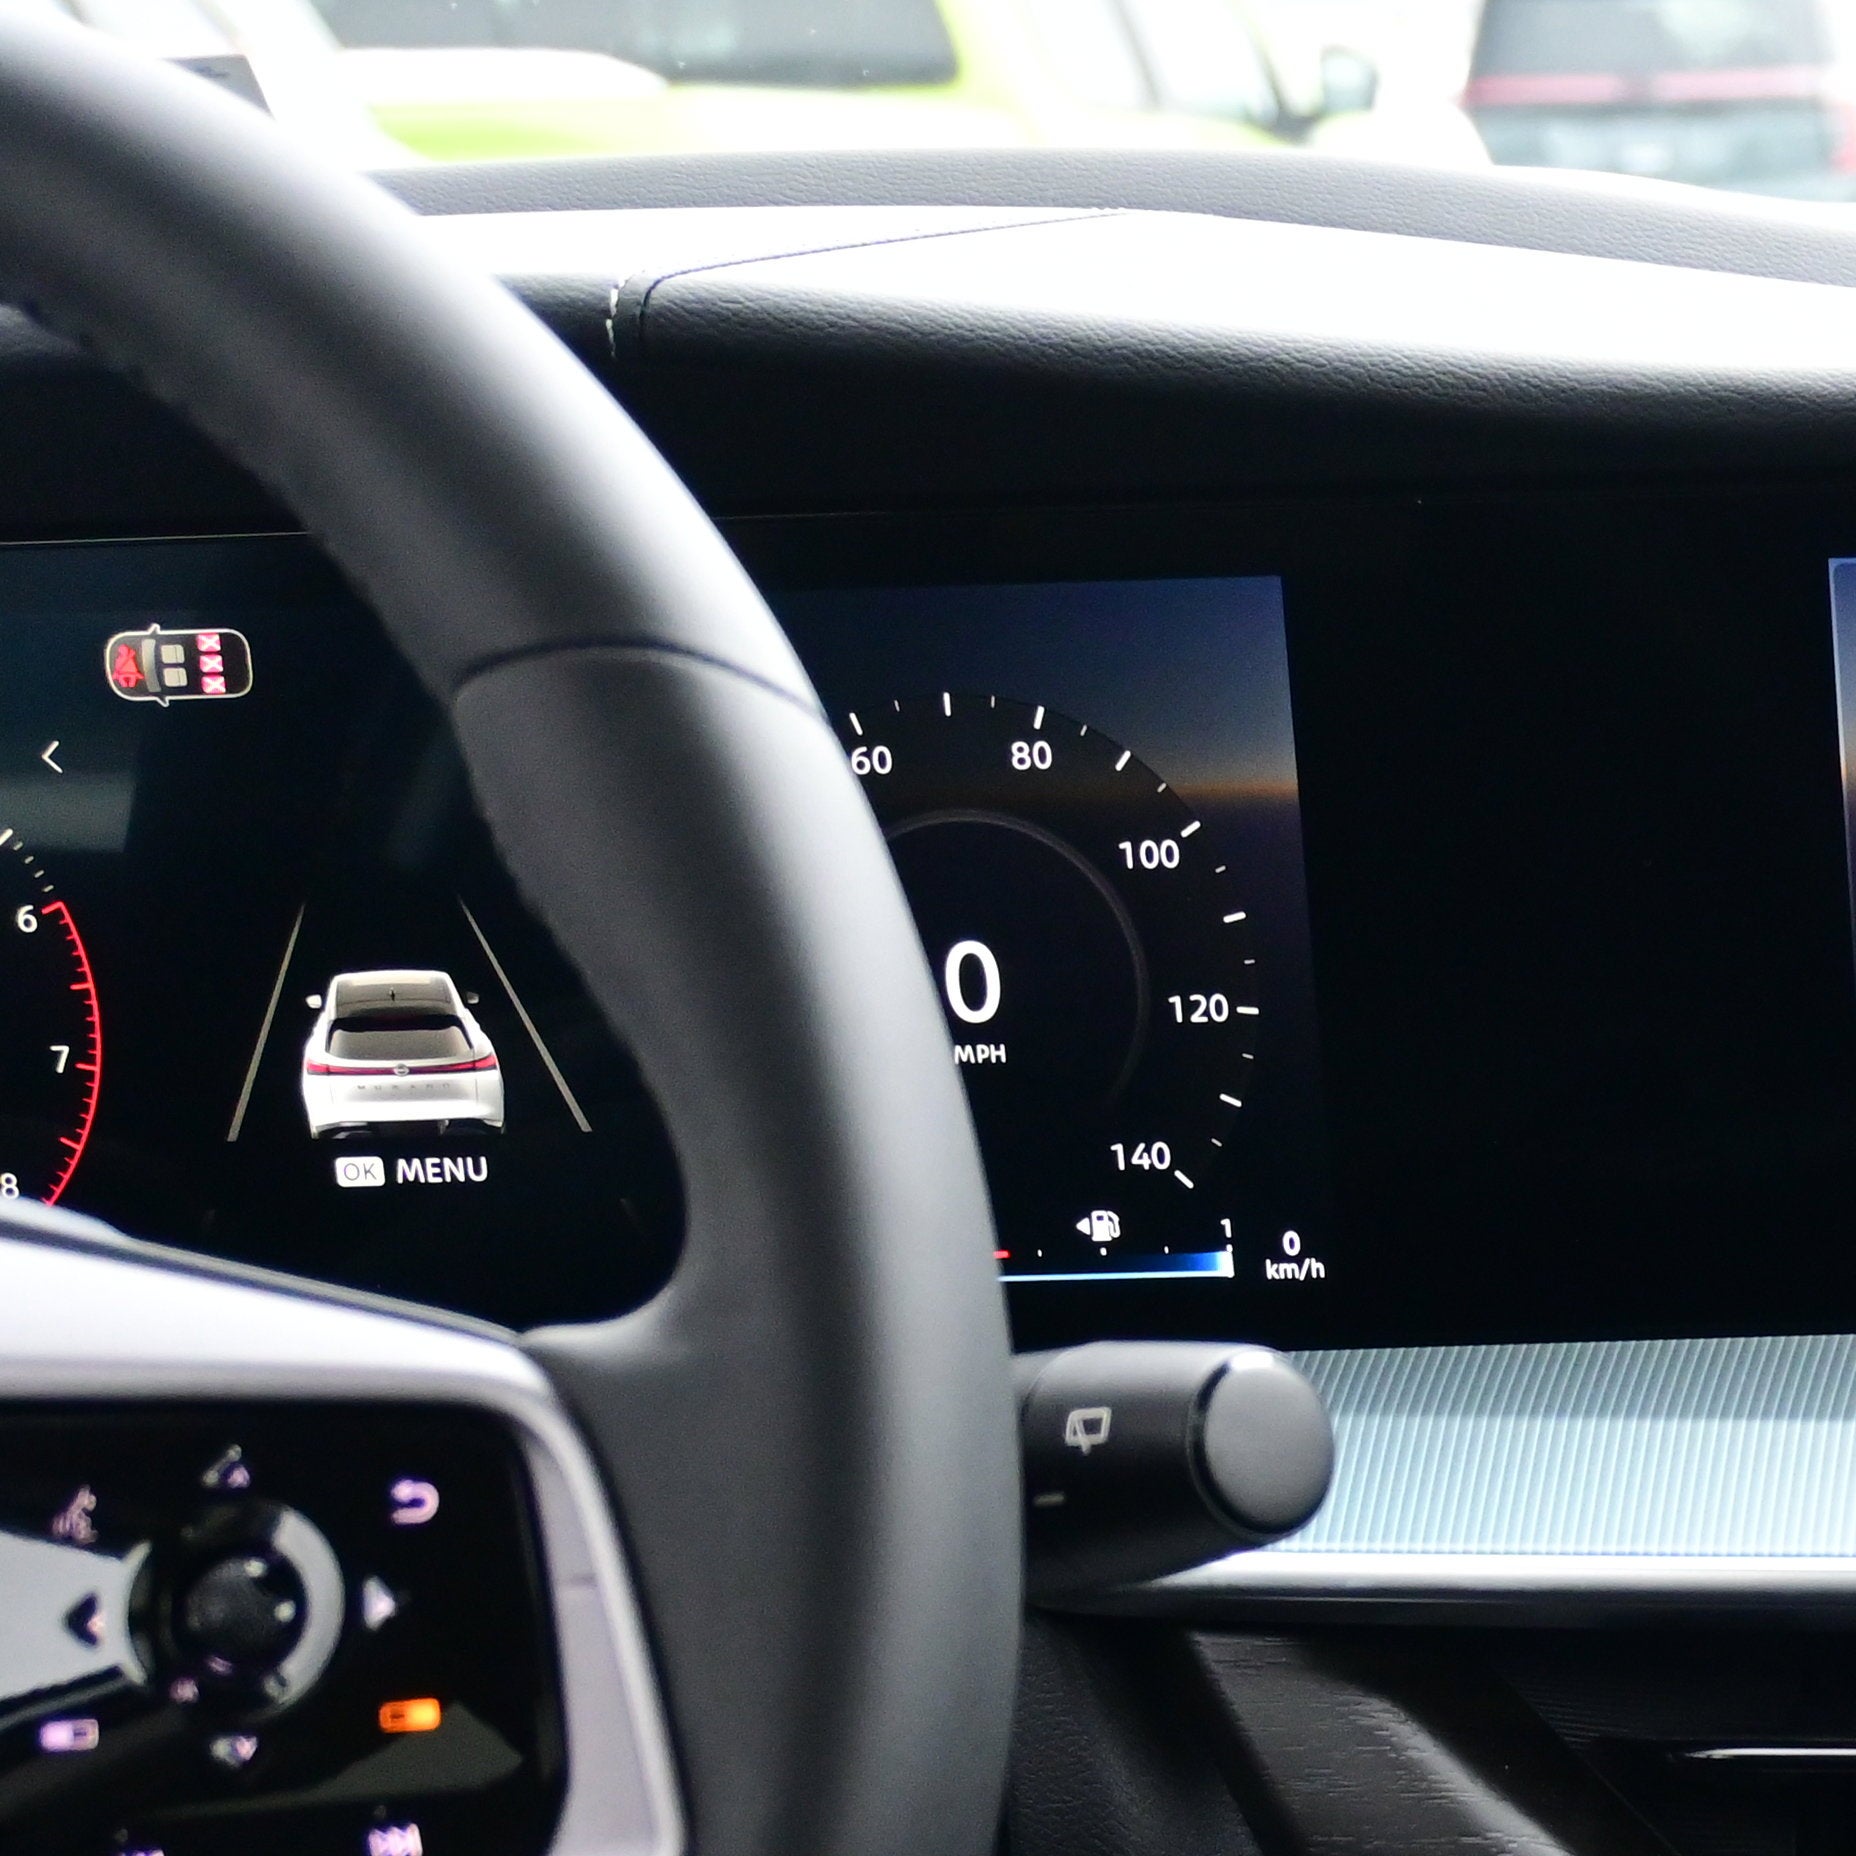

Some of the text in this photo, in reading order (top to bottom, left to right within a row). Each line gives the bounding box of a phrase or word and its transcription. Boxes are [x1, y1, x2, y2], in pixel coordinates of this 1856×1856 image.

[851, 744, 893, 775] 60
[1010, 740, 1053, 770] 80
[1119, 839, 1180, 870] 100
[16, 904, 38, 933] 6
[943, 939, 1001, 1023] 0
[1168, 993, 1229, 1023] 120
[50, 1045, 70, 1074] 7
[954, 1043, 1007, 1065] MPH
[343, 1156, 488, 1184] OK MENU
[1110, 1141, 1171, 1171] 140
[0, 1172, 20, 1200] 8
[1221, 1218, 1232, 1238] 1
[1282, 1230, 1301, 1256] 0
[1265, 1257, 1325, 1281] km/h
